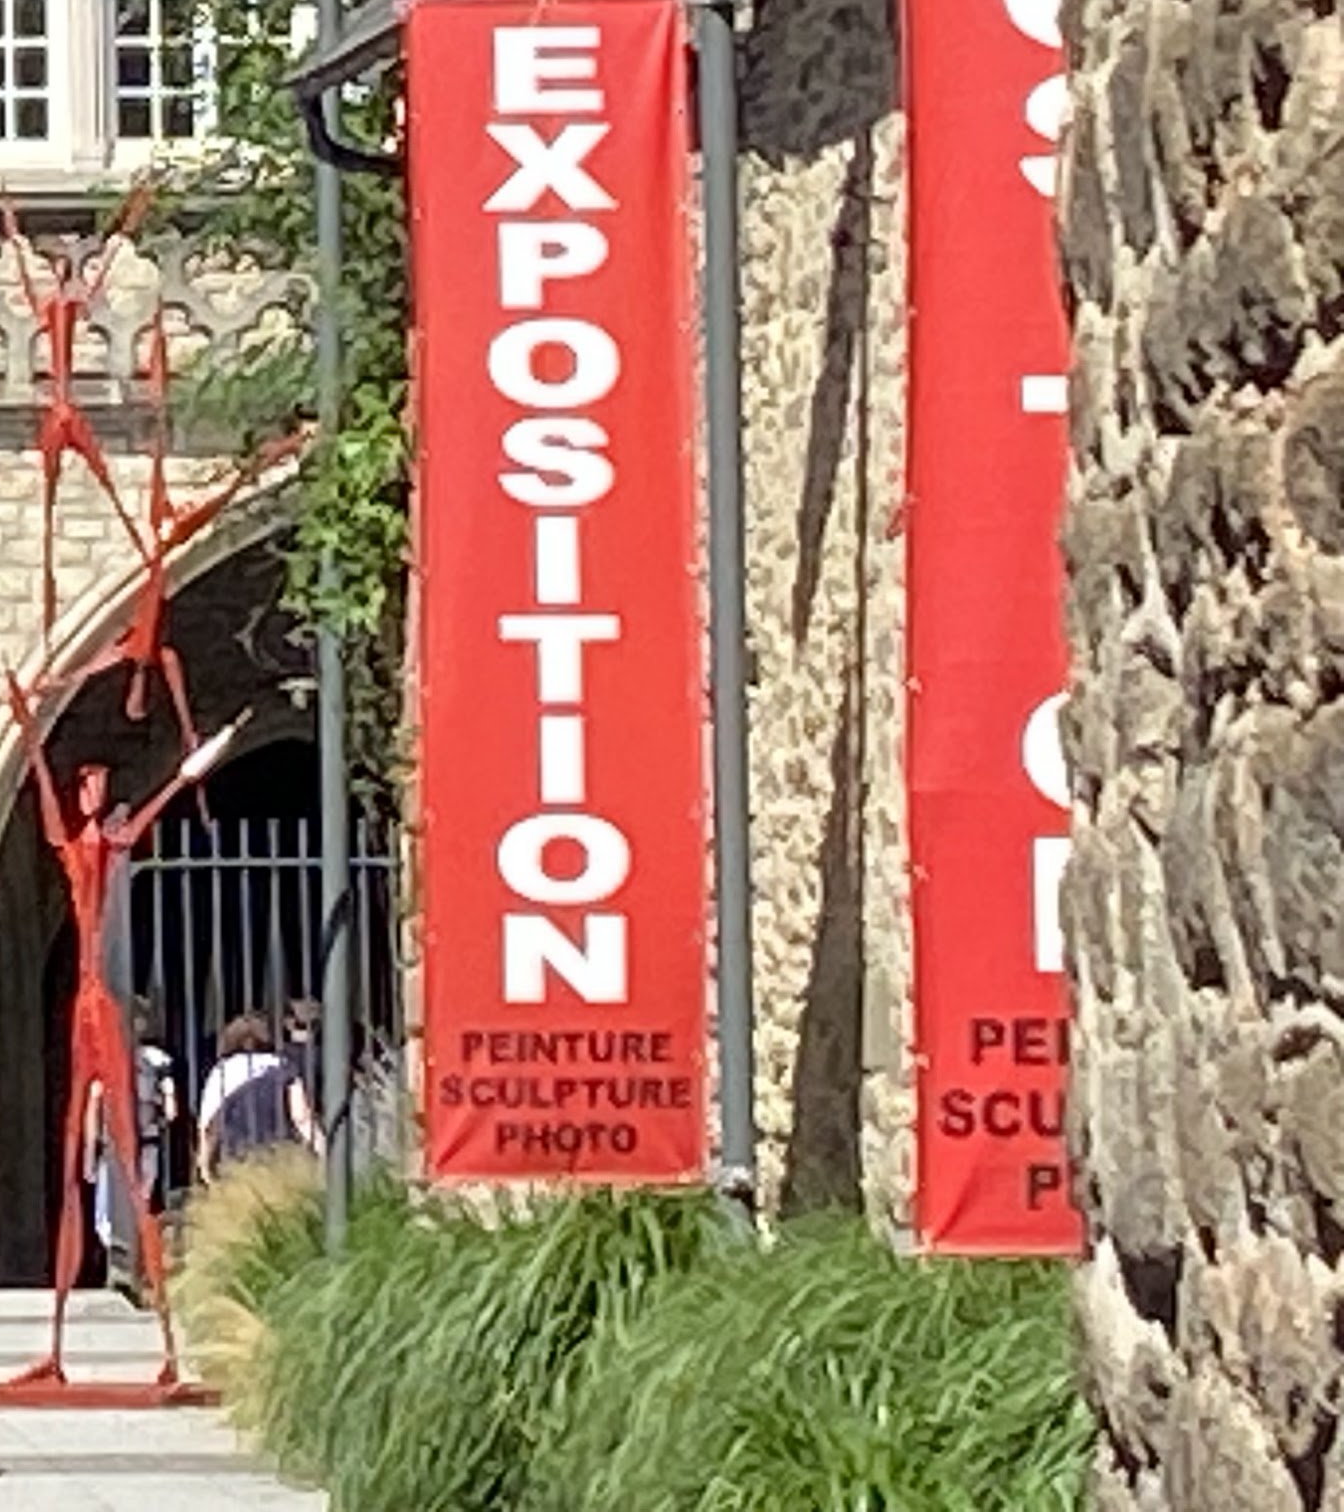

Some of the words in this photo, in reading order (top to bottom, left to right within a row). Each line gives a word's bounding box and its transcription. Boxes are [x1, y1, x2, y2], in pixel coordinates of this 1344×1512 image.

[481, 25, 630, 1004] EXPOSITION
[462, 1031, 673, 1065] PEINTURE
[438, 1074, 692, 1109] SCULPTURE
[493, 1121, 638, 1155] PHOTO
